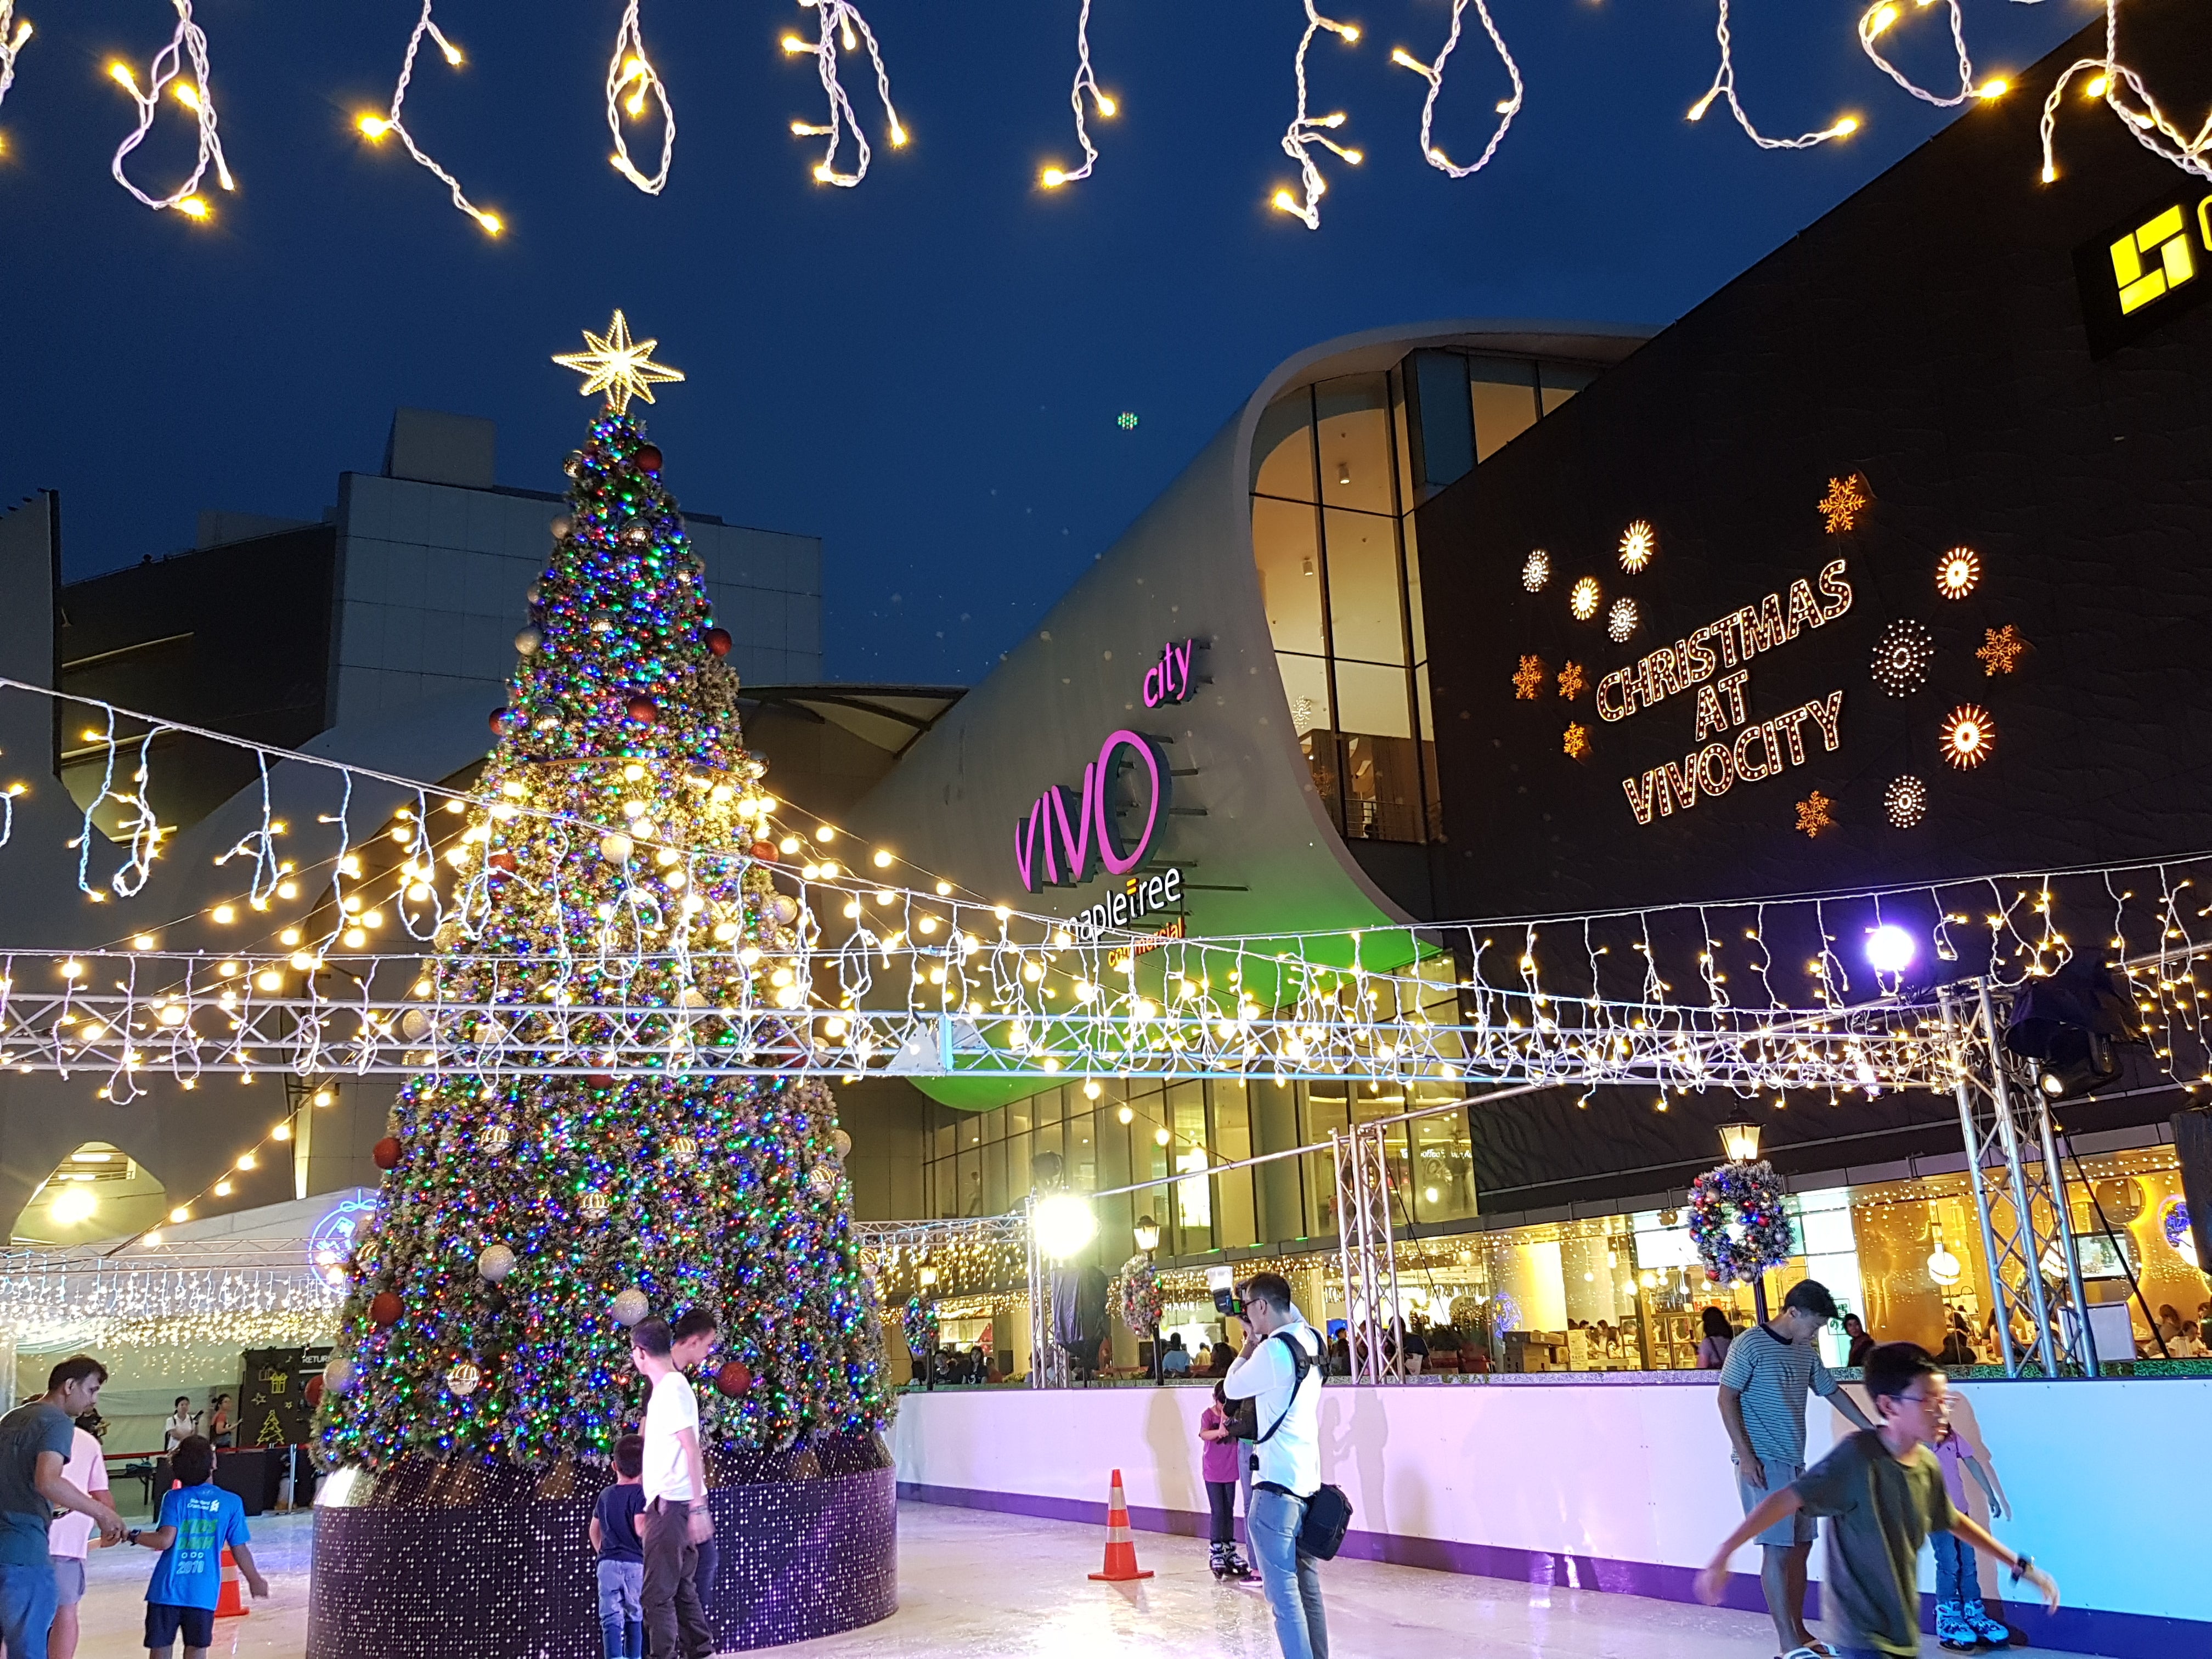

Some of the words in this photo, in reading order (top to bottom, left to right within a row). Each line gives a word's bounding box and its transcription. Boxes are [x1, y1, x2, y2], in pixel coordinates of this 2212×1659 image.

[1143, 639, 1192, 708] city
[1596, 559, 1853, 721] CHRISTMAS
[1695, 669, 1749, 741] AT
[1622, 690, 1843, 825] VIVOCITY
[1164, 1300, 1203, 1312] HANEL
